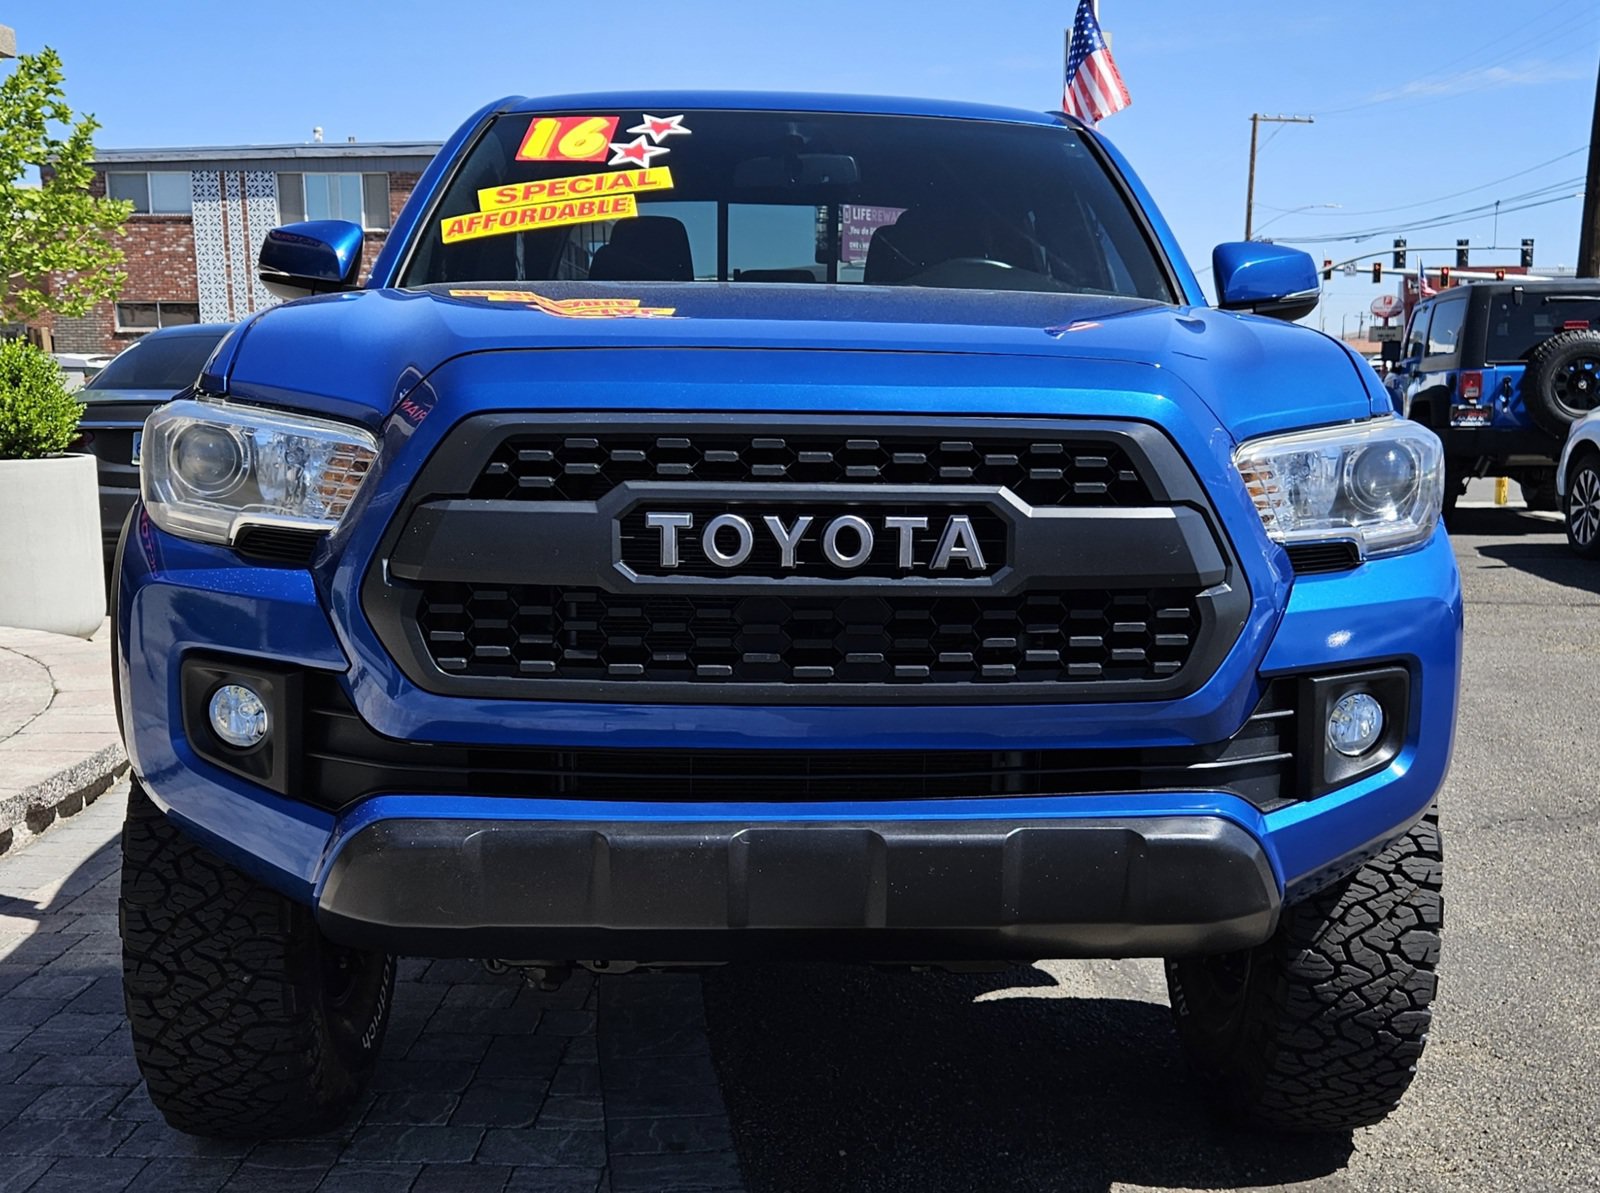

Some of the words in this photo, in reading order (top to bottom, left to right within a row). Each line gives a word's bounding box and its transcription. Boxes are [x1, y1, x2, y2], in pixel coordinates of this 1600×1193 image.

[520, 117, 611, 159] 16
[494, 170, 658, 205] SPECIAL
[446, 197, 632, 237] AFFORDABLE
[645, 511, 987, 570] TOYOTA
